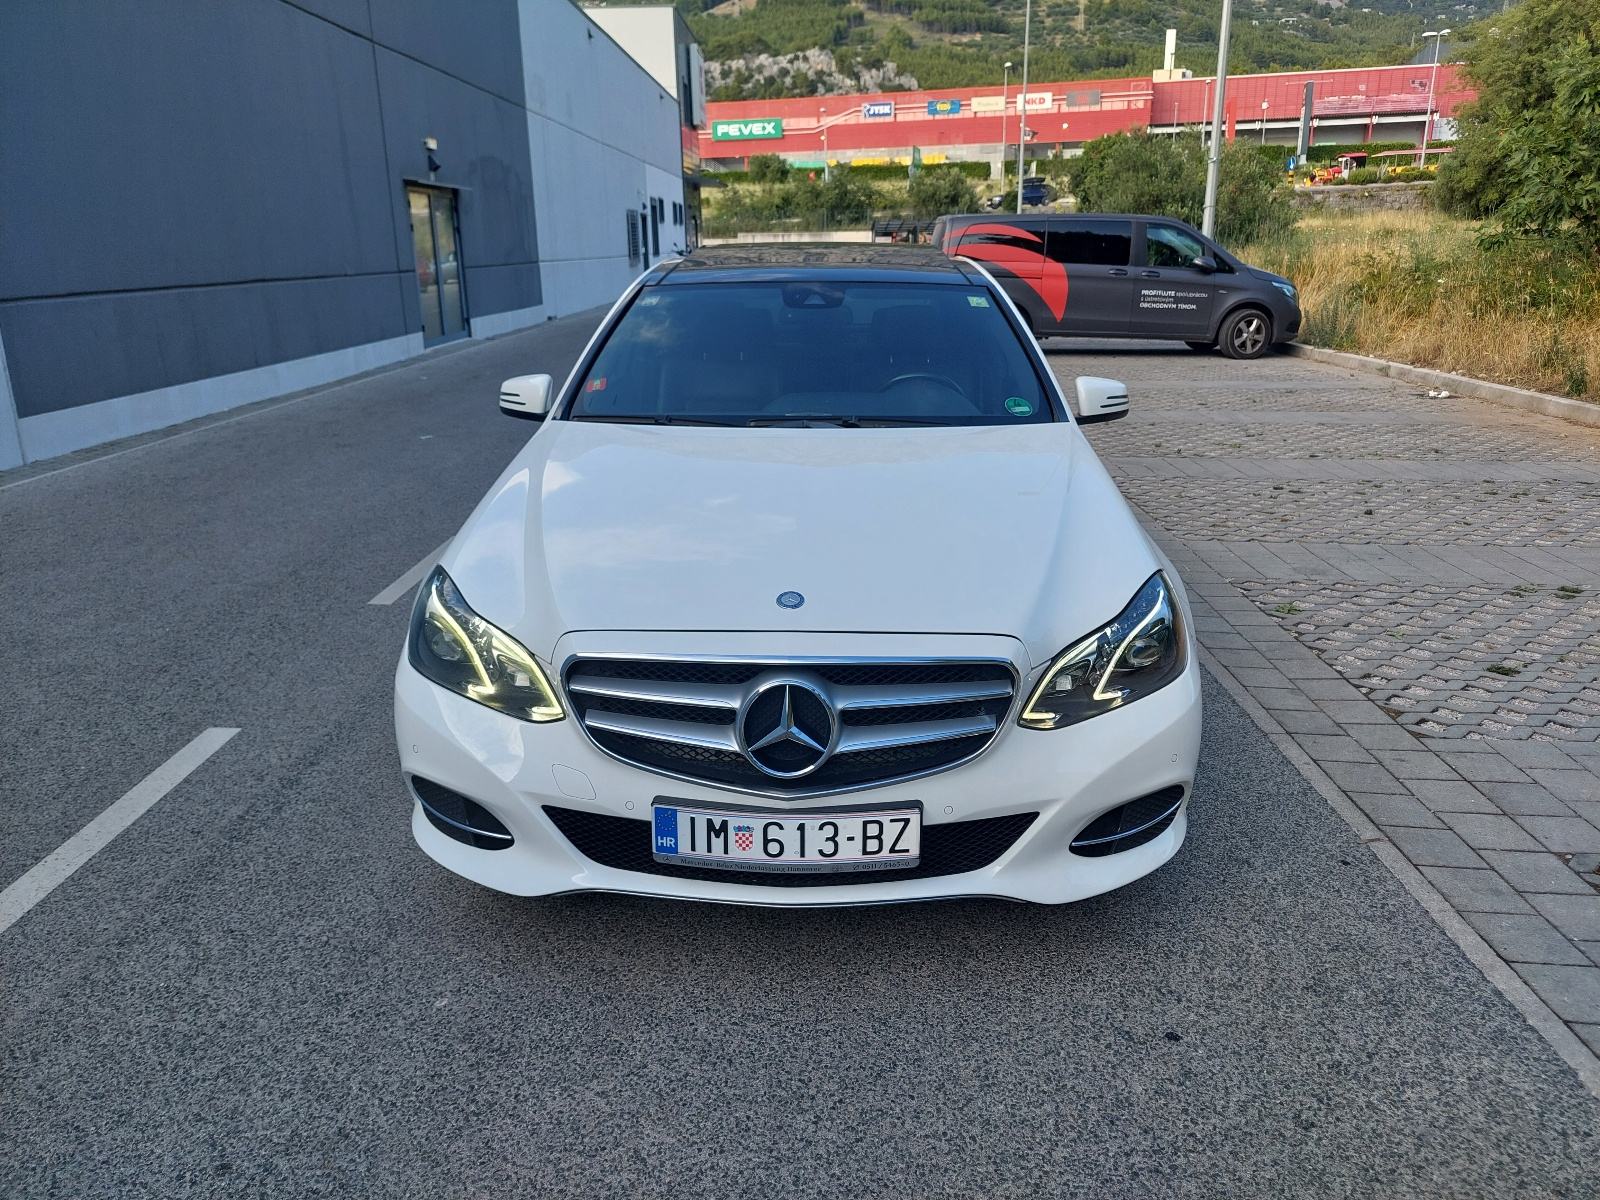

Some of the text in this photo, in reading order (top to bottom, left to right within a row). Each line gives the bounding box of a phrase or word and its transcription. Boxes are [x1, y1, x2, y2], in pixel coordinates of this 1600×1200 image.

[869, 105, 891, 115] JYSK
[716, 122, 776, 137] PEVEX
[657, 836, 676, 848] HR
[690, 816, 911, 858] IM 613-BZ
